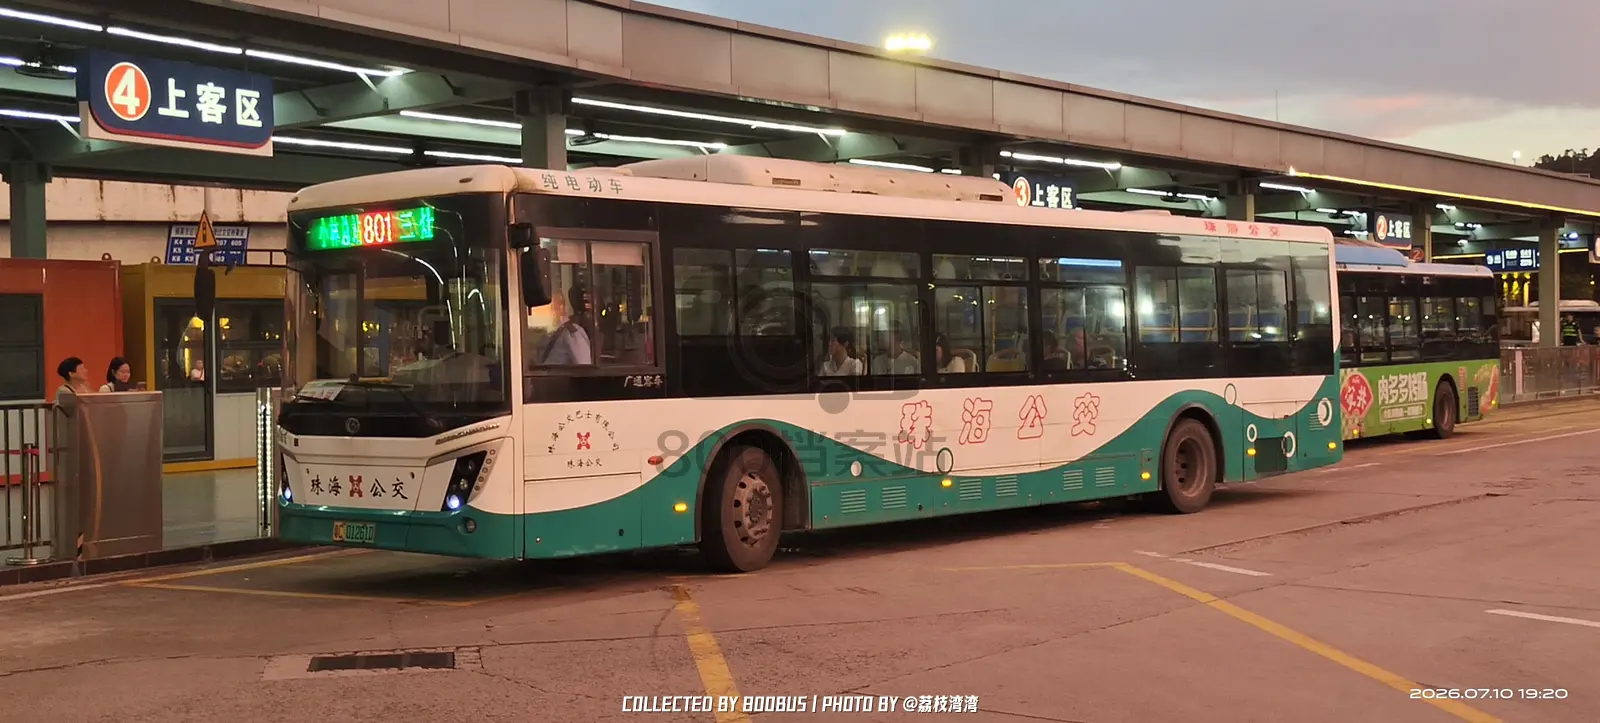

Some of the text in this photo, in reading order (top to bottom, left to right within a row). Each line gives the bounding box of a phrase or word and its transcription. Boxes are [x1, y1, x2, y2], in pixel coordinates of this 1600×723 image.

[112, 68, 263, 127] 4 上客区
[541, 173, 623, 194] 纯电动车
[1032, 183, 1073, 209] 上客区
[363, 212, 393, 244] 801
[1387, 220, 1411, 239] 上客区
[898, 391, 1101, 450] 珠海公交
[309, 476, 409, 501] 珠海 公交
